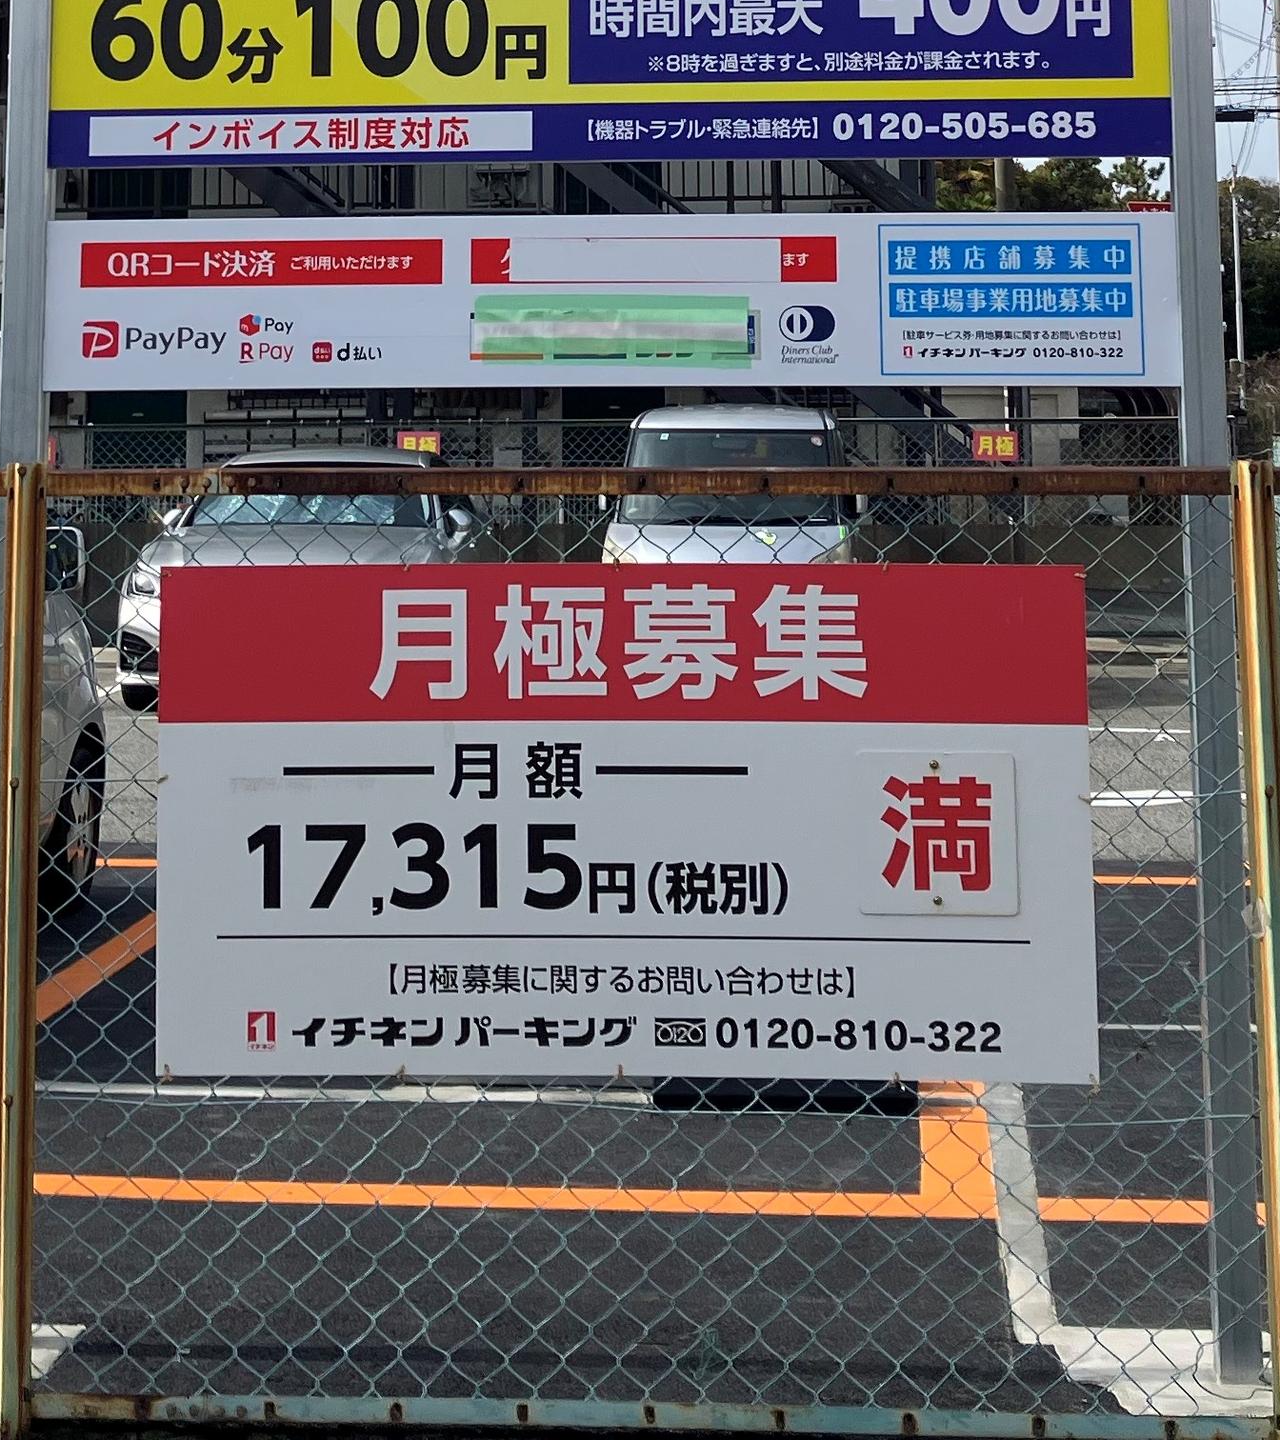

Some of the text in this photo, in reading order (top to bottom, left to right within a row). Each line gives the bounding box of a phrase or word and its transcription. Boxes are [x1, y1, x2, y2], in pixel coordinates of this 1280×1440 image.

[647, 50, 1051, 73] ※8時を過ぎますと、別途料金が課金されます。
[153, 117, 470, 151] インボイス制度対応
[586, 112, 1097, 142] 【機器トラブル・緊急連絡先】 0120-505-685
[108, 250, 413, 278] QRコード決済 ご利用いただけます
[782, 253, 809, 266] ます
[894, 245, 1125, 271] 提携店舗募集中
[895, 288, 1127, 313] 駐車場事業用地募集中
[265, 318, 294, 335] Pay
[125, 327, 227, 355] PayPay
[259, 343, 294, 363] Pay
[337, 343, 382, 361] d払い
[781, 345, 833, 355] Diners Club
[1032, 347, 1124, 359] 0120-810-322
[781, 354, 838, 364] International
[978, 436, 1014, 456] 月極
[369, 583, 868, 701] 月極募集
[448, 741, 583, 800] 月額
[879, 774, 993, 893] 満
[389, 963, 855, 998] 【月極募集に関するお問い合わせは】
[717, 1017, 1002, 1053] 0120-810-322
